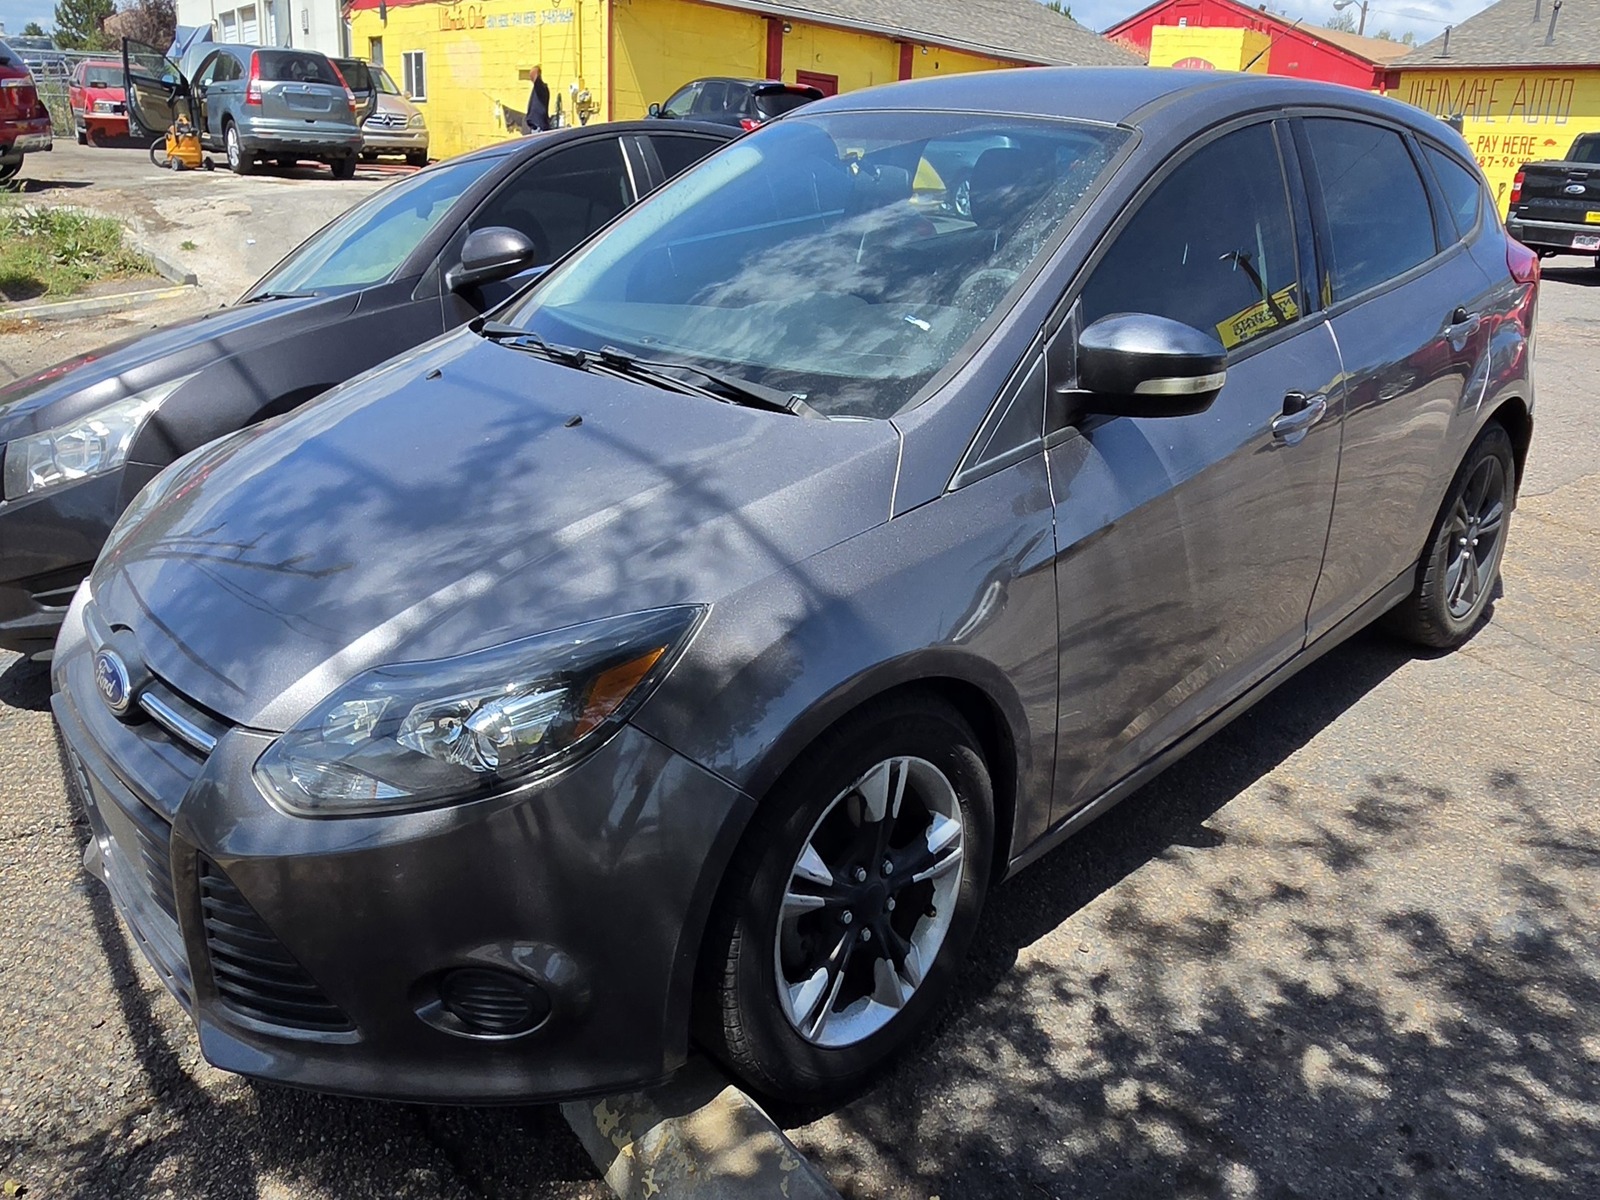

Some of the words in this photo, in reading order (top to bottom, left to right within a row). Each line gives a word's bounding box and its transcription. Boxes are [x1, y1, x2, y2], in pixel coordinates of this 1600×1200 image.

[1507, 78, 1575, 125] AUTO
[1476, 135, 1499, 153] PAY
[1501, 136, 1538, 155] HERE
[96, 658, 116, 698] Ford
